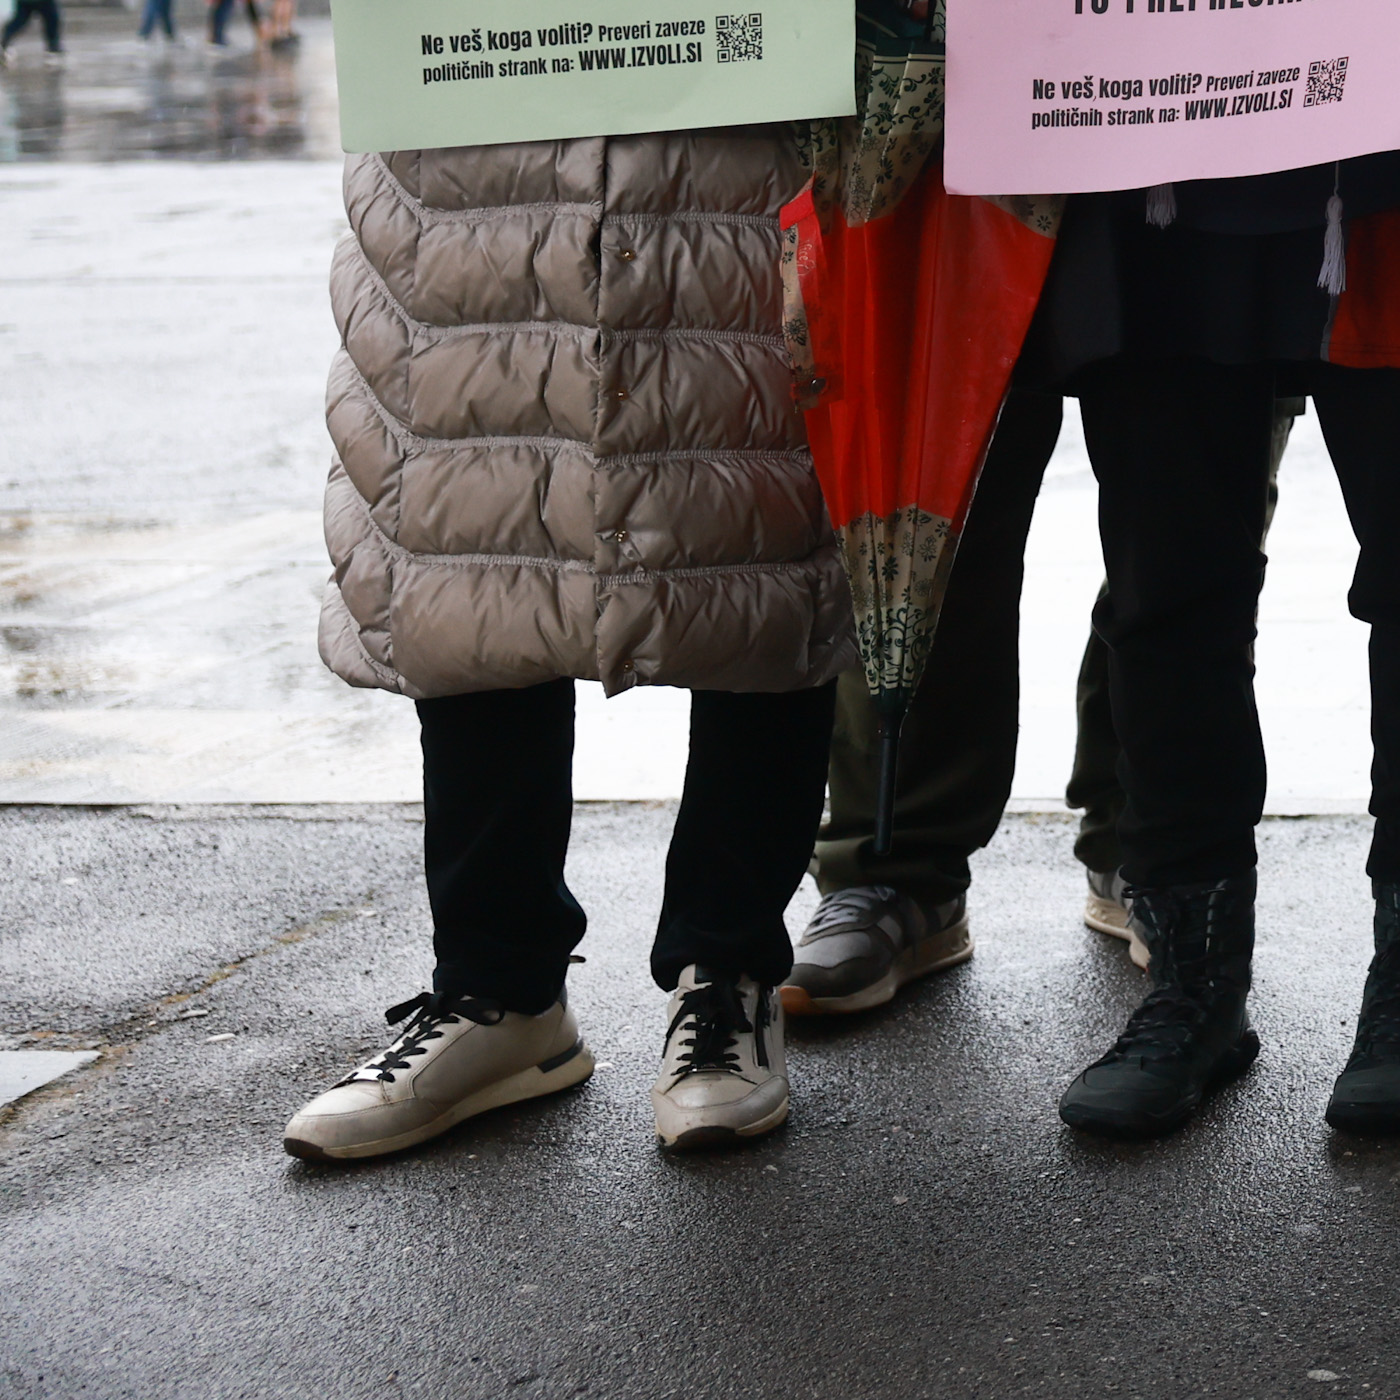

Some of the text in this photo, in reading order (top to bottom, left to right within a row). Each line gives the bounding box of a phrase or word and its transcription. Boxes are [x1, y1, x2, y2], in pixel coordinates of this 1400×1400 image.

[421, 35, 443, 55] Ne
[488, 31, 532, 51] koga
[537, 22, 592, 46] voliti?
[599, 21, 650, 42] Preveri
[655, 20, 705, 37] zaveze
[423, 40, 701, 85] političnih strank na: WWW.IZVOLI.SI
[1033, 79, 1055, 99] Ne
[1099, 78, 1143, 100] koga
[1149, 73, 1202, 96] voliti?
[1206, 70, 1254, 92] Preveri
[1257, 67, 1300, 86] zaveze
[1032, 88, 1293, 130] političnih strank na: WWW.IZVOLI.SI
